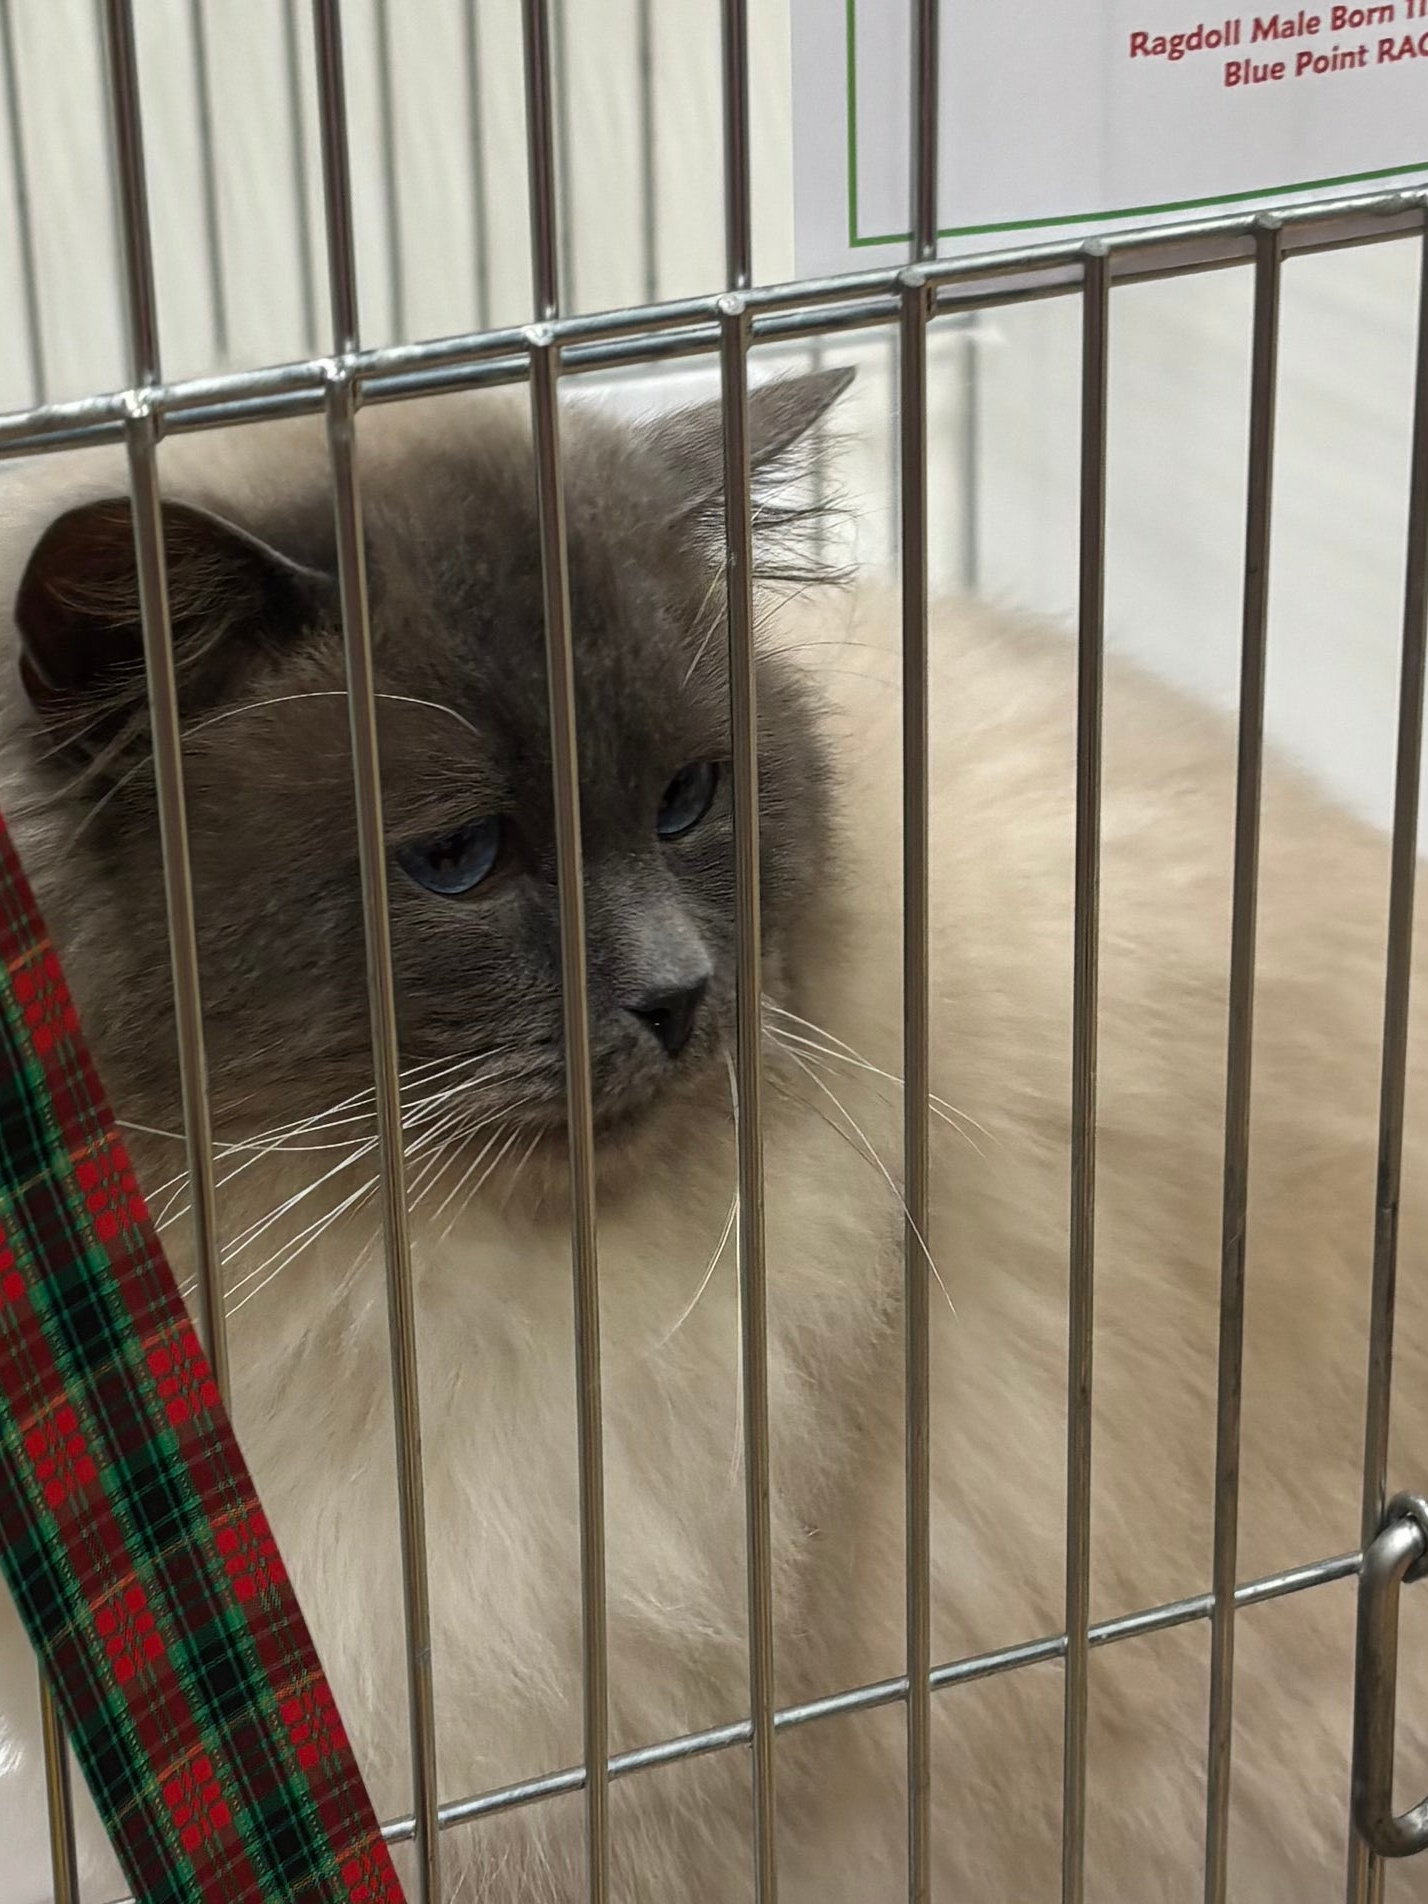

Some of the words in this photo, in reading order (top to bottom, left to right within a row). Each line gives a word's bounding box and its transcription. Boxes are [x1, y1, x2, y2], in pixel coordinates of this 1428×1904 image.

[1128, 18, 1241, 62] Ragdoll
[1249, 9, 1321, 45] Male
[1329, 0, 1396, 33] Born
[1223, 56, 1287, 88] Blue
[1294, 43, 1370, 78] Point
